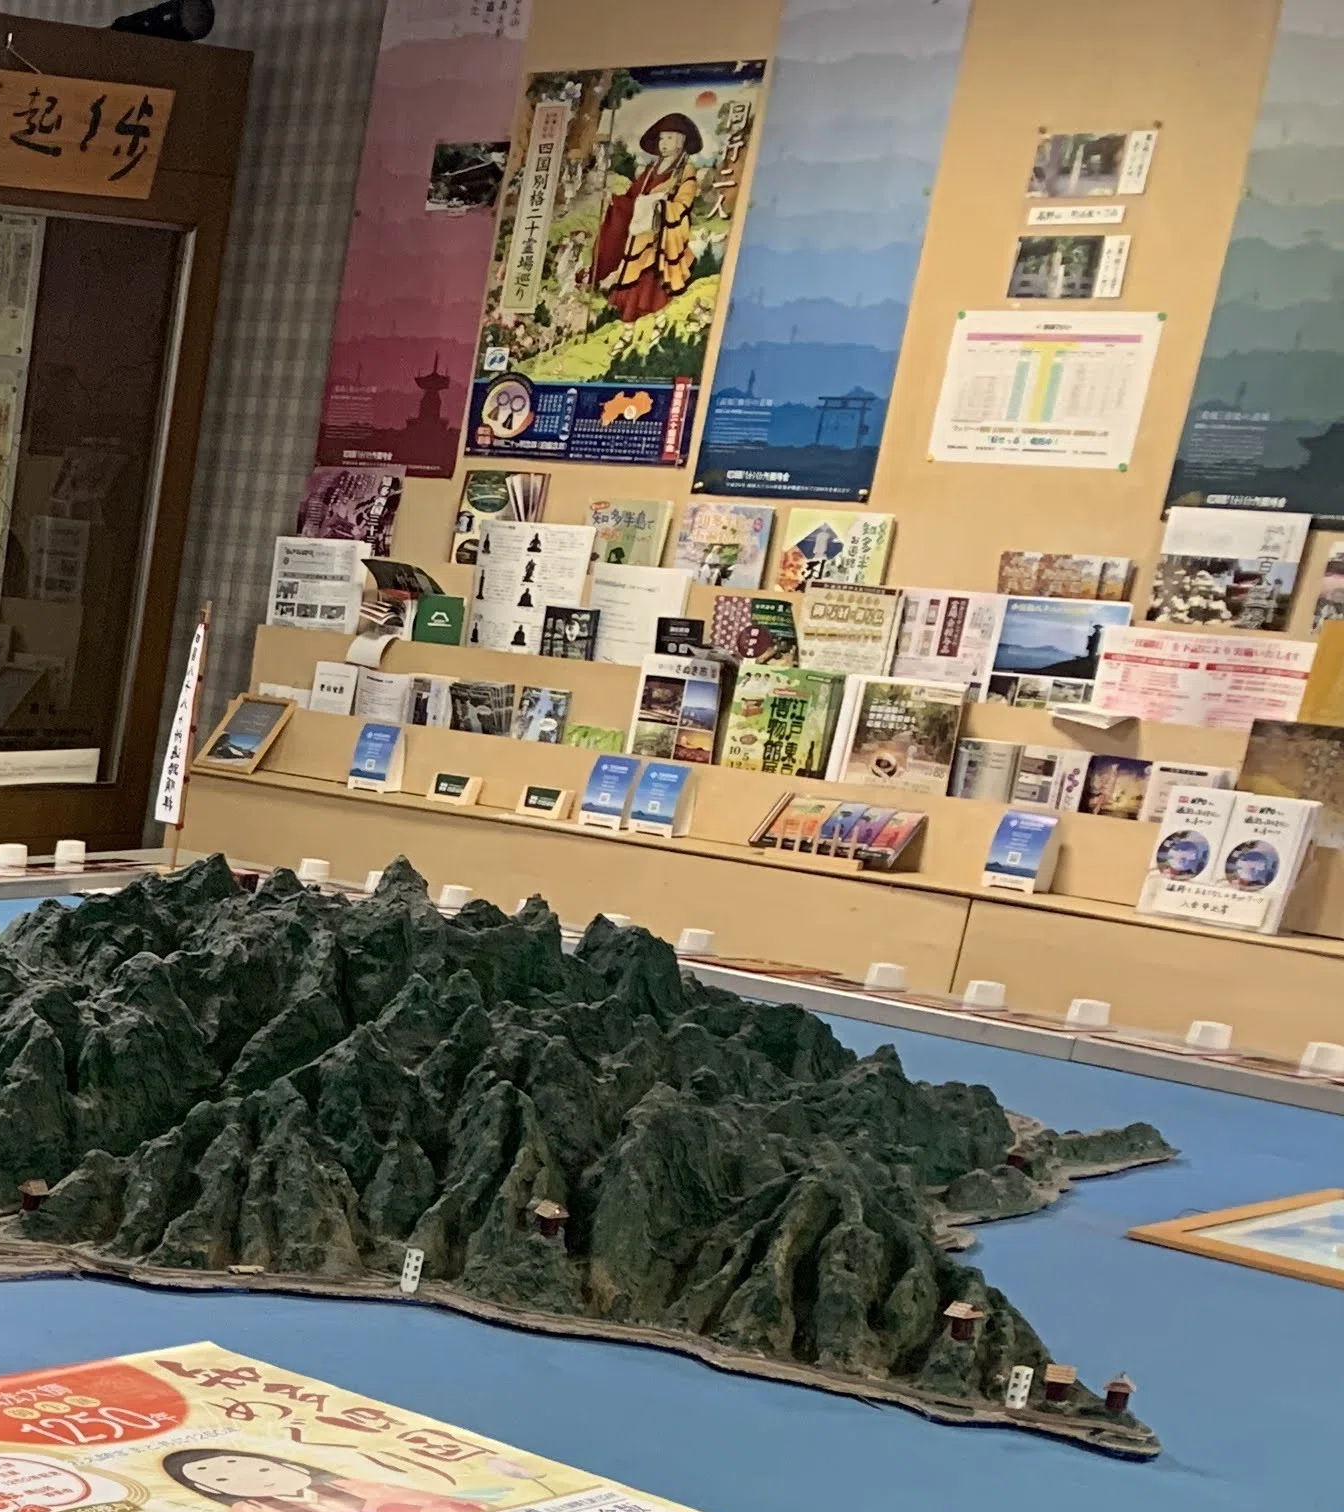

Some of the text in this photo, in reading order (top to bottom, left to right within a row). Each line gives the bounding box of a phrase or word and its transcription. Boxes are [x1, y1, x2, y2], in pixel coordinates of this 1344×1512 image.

[707, 100, 752, 219] 同行二人
[515, 142, 555, 301] 四国別格二十霊場巡り
[155, 1360, 499, 1461] 知多四国
[204, 1396, 457, 1485] めぐり
